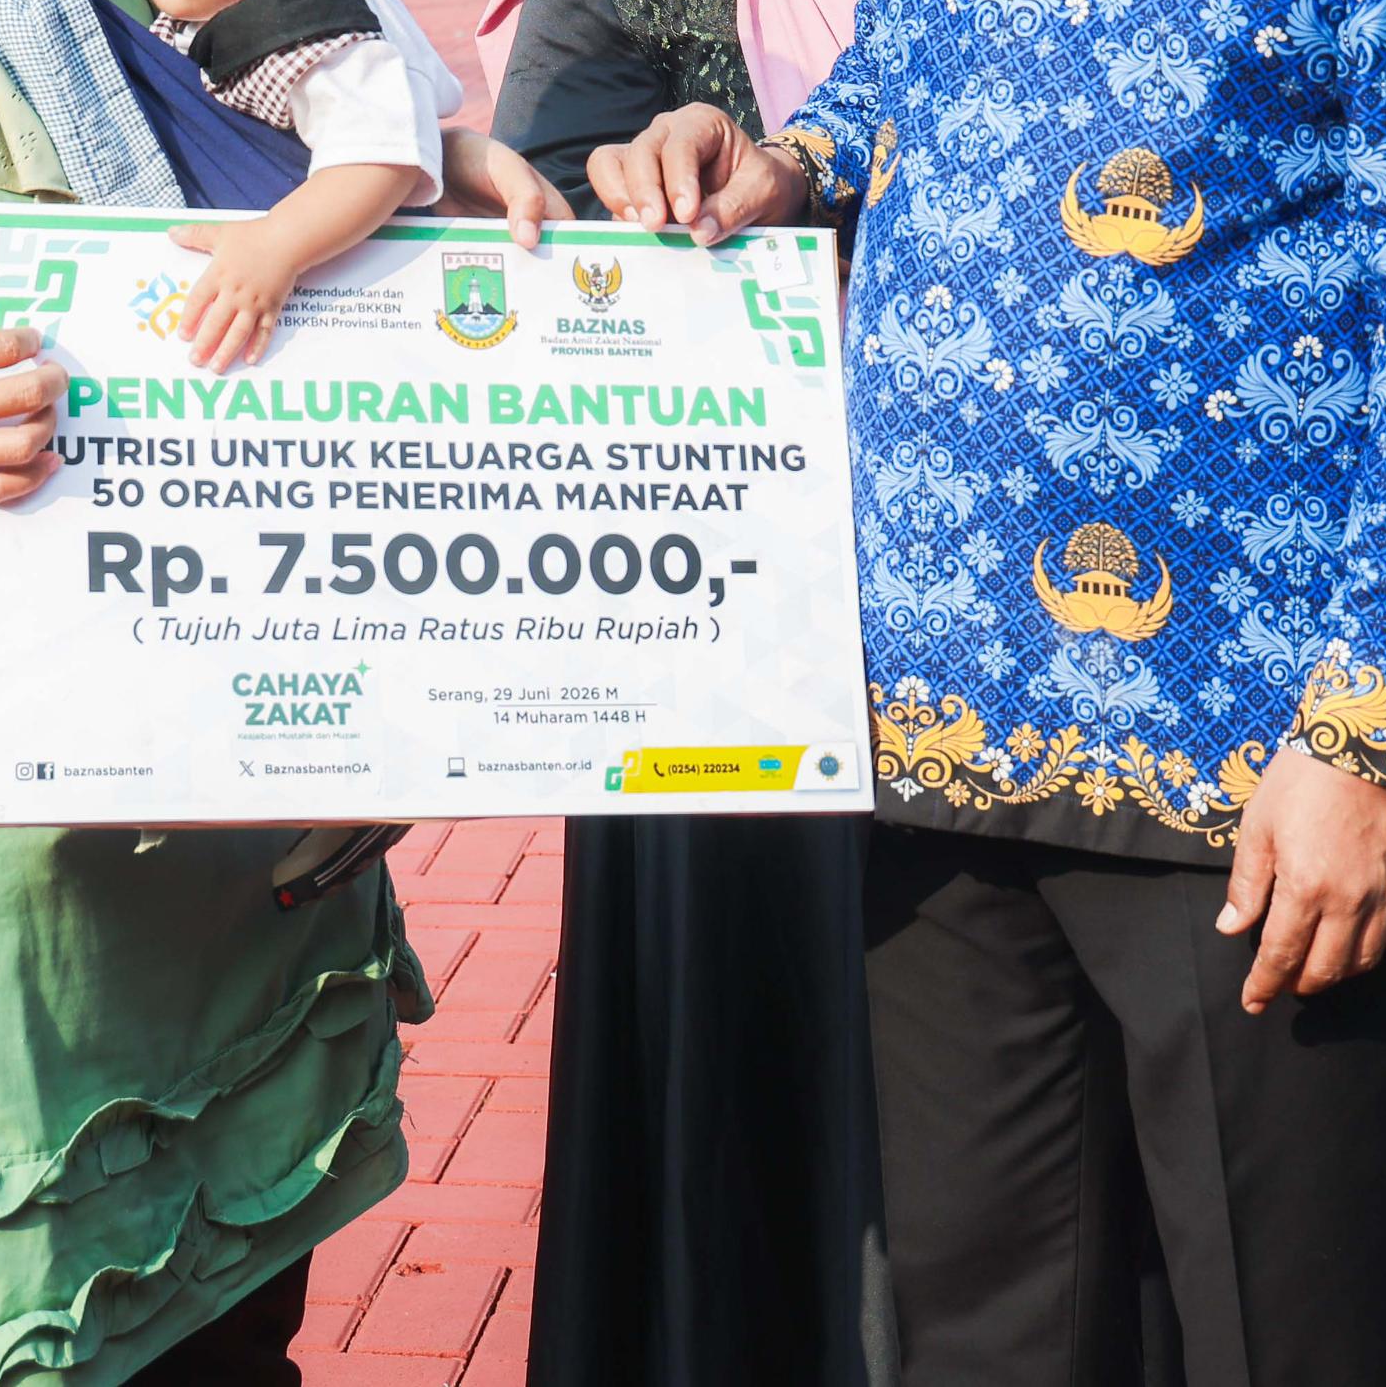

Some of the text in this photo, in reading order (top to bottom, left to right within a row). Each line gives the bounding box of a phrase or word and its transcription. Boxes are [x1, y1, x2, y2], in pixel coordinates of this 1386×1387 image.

[293, 286, 404, 299] Kependudukan dan
[301, 301, 401, 315] Keluarga/BKKBN
[284, 316, 329, 328] BKKBN
[332, 317, 378, 328] Provinsi
[381, 318, 421, 329] Banten
[557, 318, 645, 335] BAZNAS
[551, 347, 653, 357] PROVINSI BANTEN
[68, 376, 766, 427] PENYALURAN BANTUAN
[211, 439, 356, 468] UNTUK
[371, 441, 594, 470] KELUARGA
[607, 444, 805, 471] STUNTING
[93, 478, 748, 510] 50 ORANG PENERIMA MANFAAT
[88, 532, 757, 607] Rp. 7.500.000,-
[159, 617, 240, 645] Tujuh
[252, 618, 319, 640] Juta
[333, 617, 406, 640] Lima
[419, 618, 504, 640] Ratus
[516, 617, 584, 640] Ribu
[596, 616, 697, 644] Rupiah
[232, 673, 363, 696] CAHAYA
[429, 687, 618, 703] Serang, 29 Juni 2026 M
[245, 703, 351, 725] ZAKAT
[494, 710, 645, 724] 14 Muharam 1448 H
[64, 765, 154, 777] baznasbanten
[265, 763, 371, 774] BaznasbantenOA
[478, 760, 592, 771] baznasbanten.or.id
[667, 763, 741, 775] (0254) 220234
